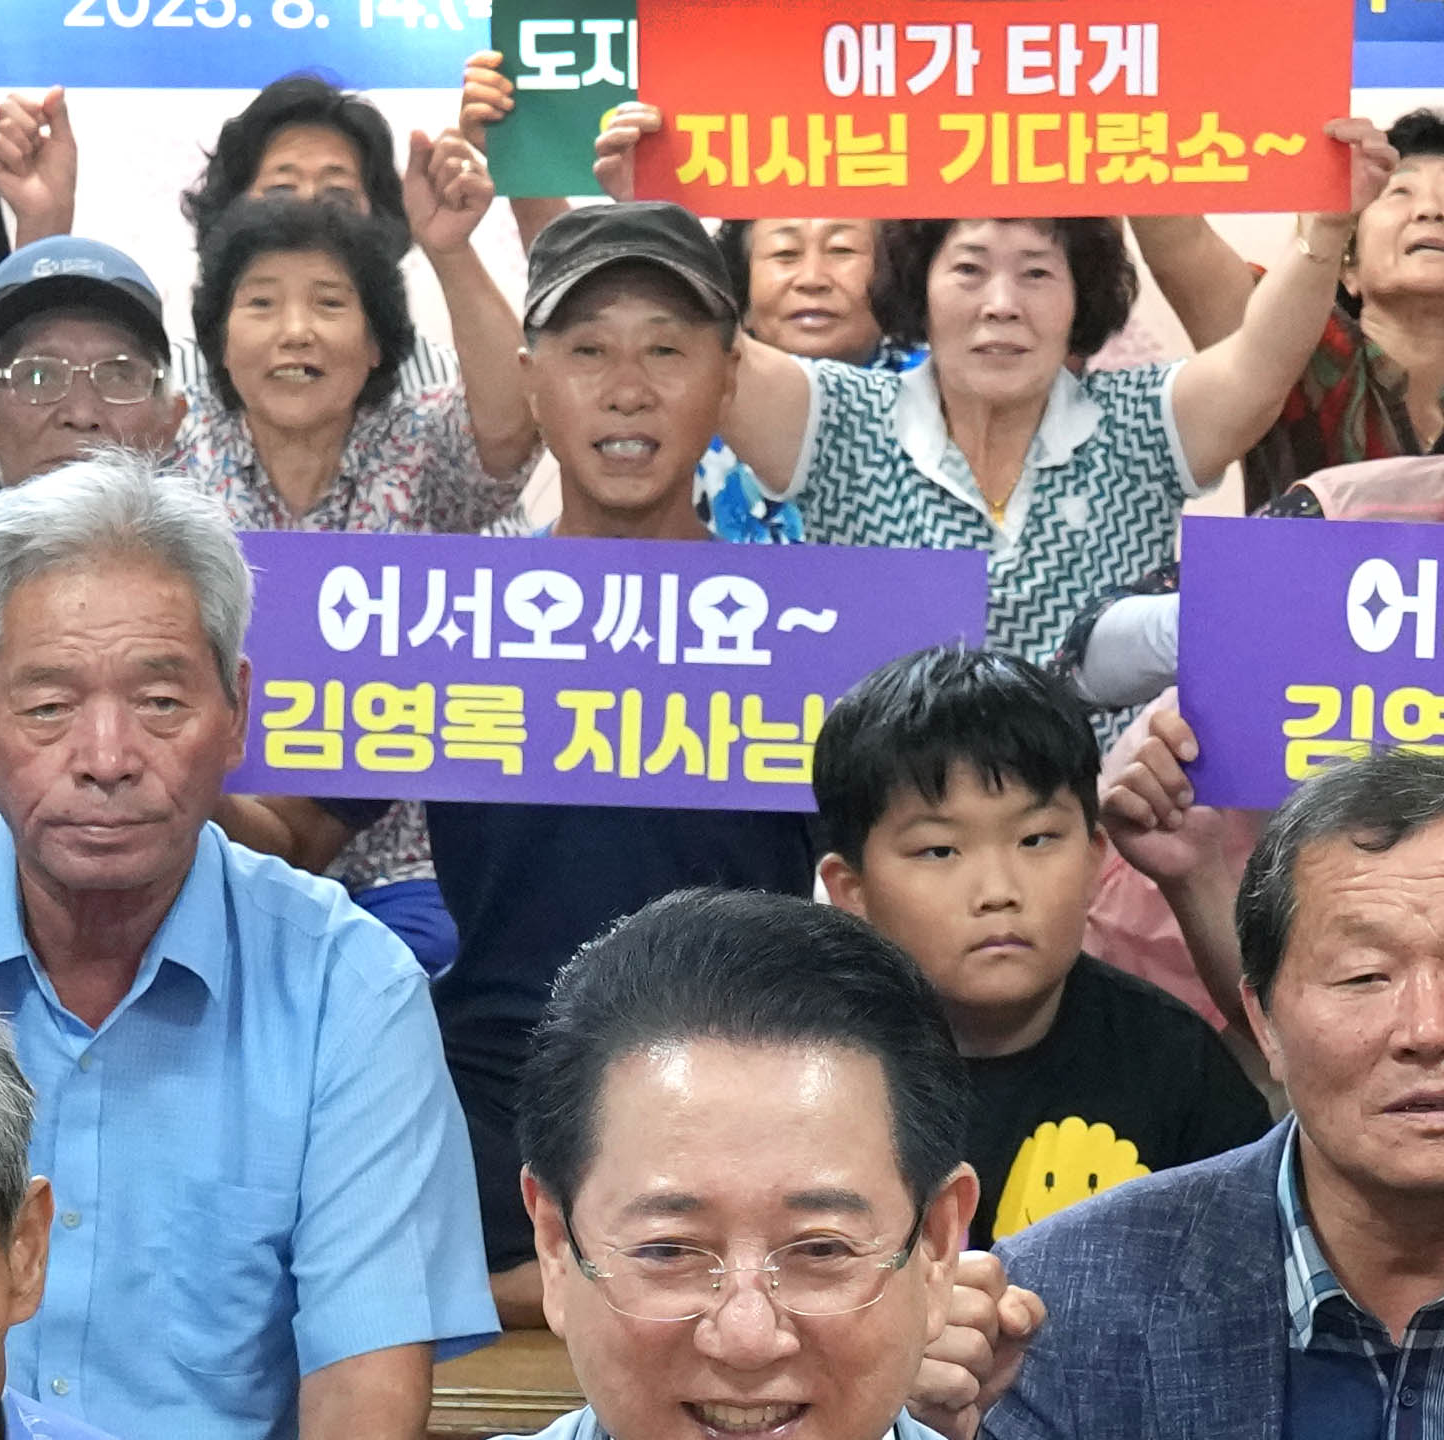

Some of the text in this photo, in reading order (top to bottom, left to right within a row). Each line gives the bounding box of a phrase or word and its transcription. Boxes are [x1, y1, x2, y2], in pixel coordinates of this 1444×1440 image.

[824, 23, 1158, 97] 애가 타게
[675, 111, 1307, 188] 지사님 기다렸소~
[318, 565, 838, 666] 어서오씨요~
[263, 682, 525, 774] 김영록
